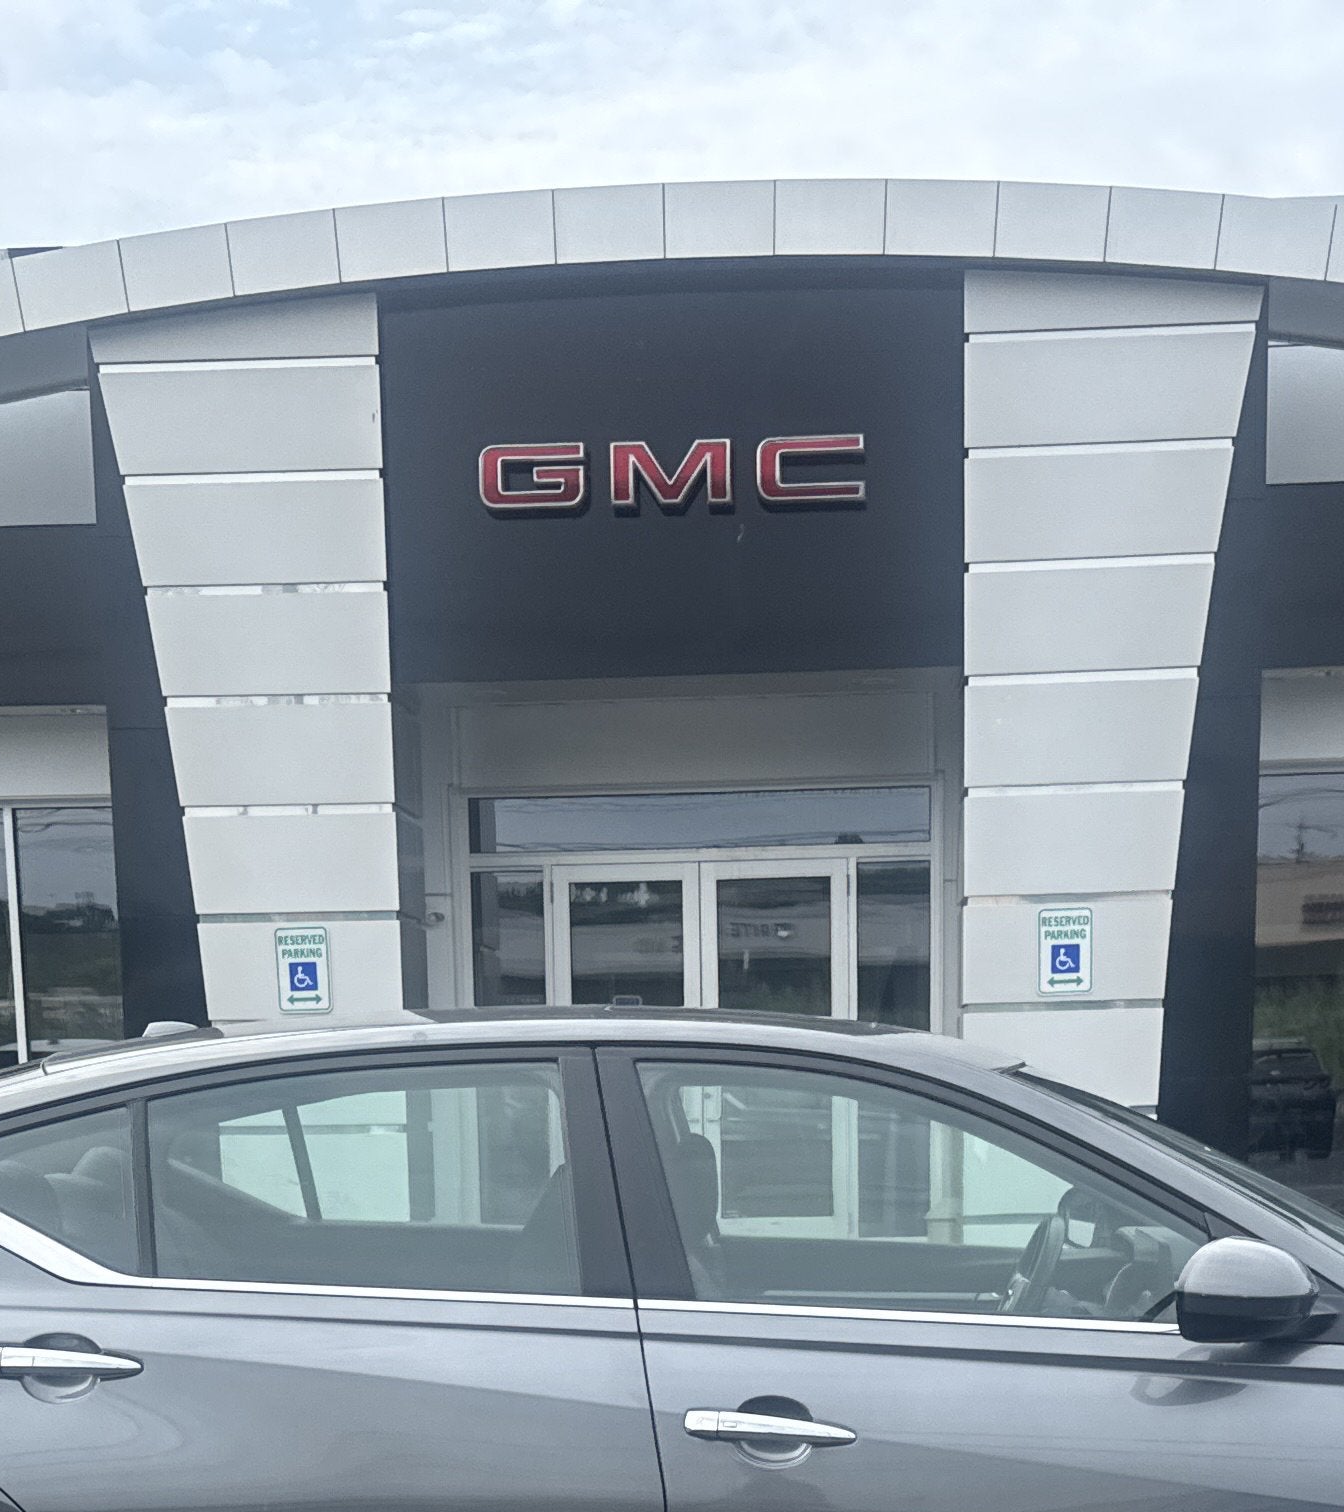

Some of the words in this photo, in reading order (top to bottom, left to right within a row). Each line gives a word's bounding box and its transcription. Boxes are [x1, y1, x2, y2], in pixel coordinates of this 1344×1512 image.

[479, 433, 865, 509] GMC
[1041, 916, 1090, 927] RESERVED
[278, 935, 325, 946] RESERVED
[1044, 929, 1087, 941] PARKING
[281, 948, 323, 959] PARKING
